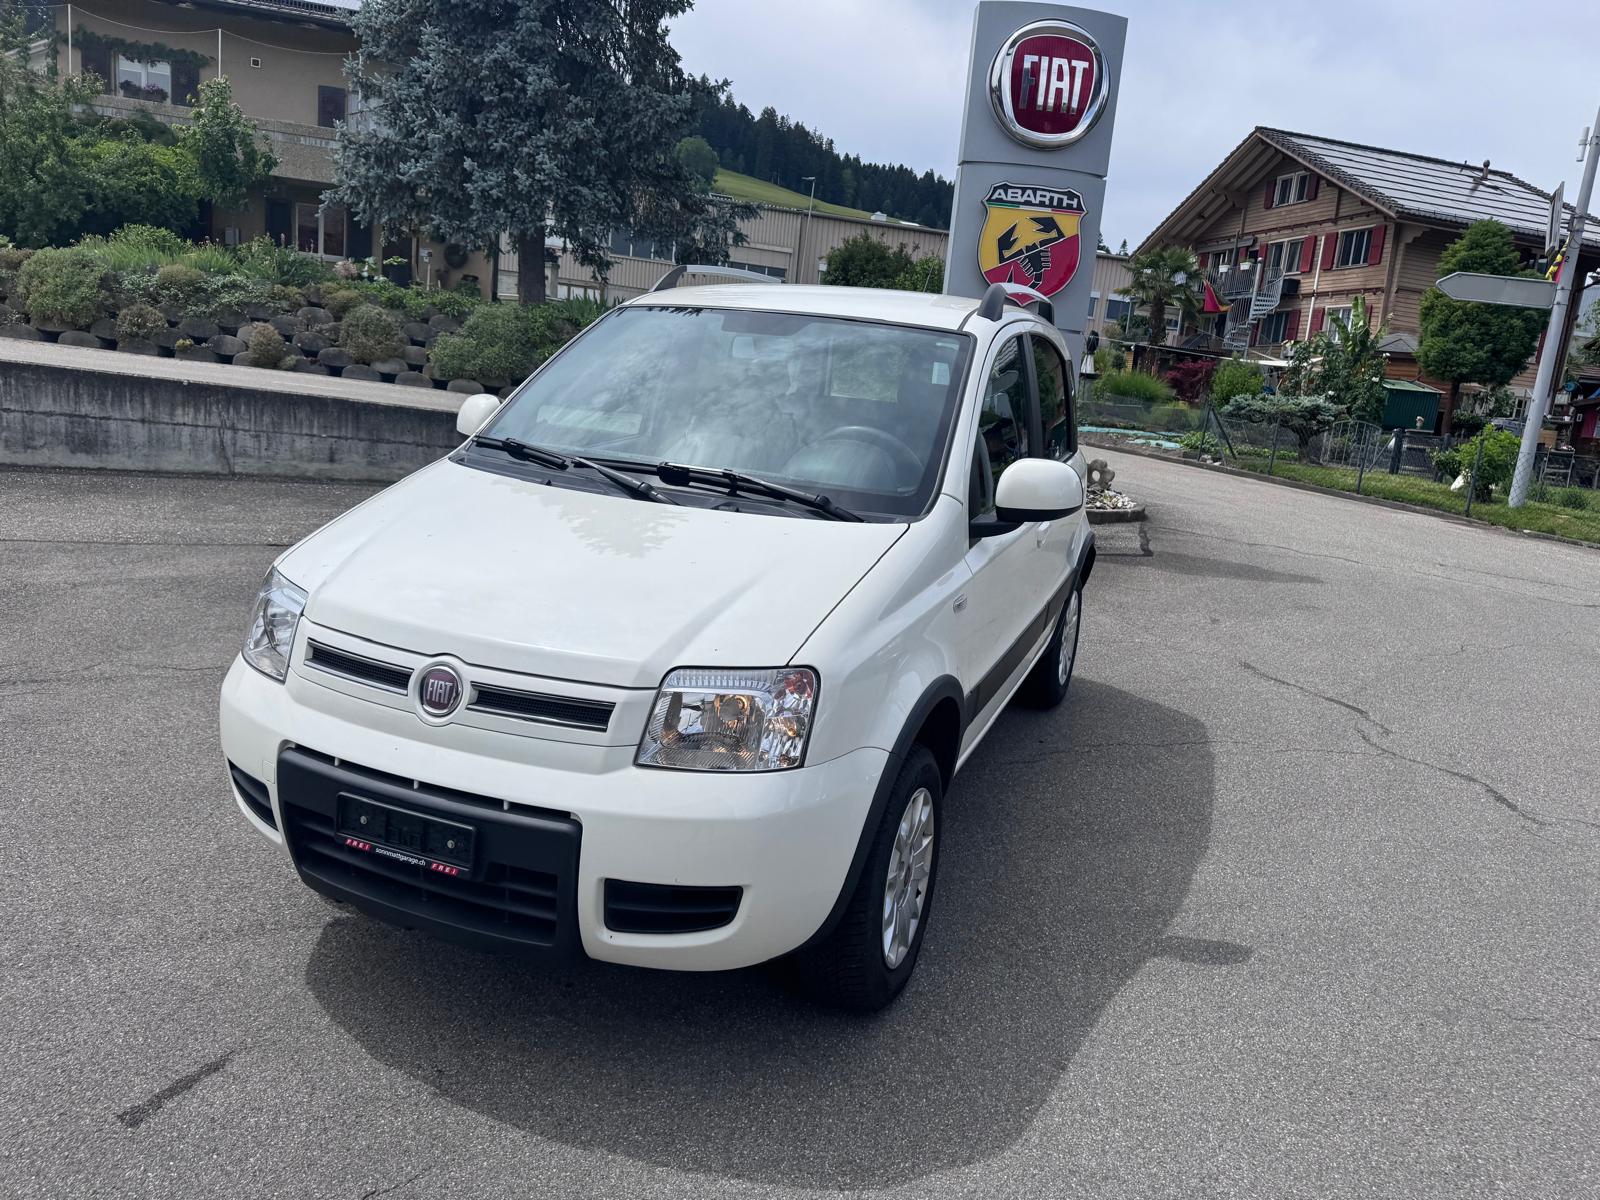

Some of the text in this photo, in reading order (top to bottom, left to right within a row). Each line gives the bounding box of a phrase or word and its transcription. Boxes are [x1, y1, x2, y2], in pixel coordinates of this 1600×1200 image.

[1018, 54, 1089, 115] FIAT
[991, 188, 1079, 208] ABARTH
[426, 678, 453, 704] FIAT
[345, 838, 457, 875] FREI sonnmattgarage.ch FREI
